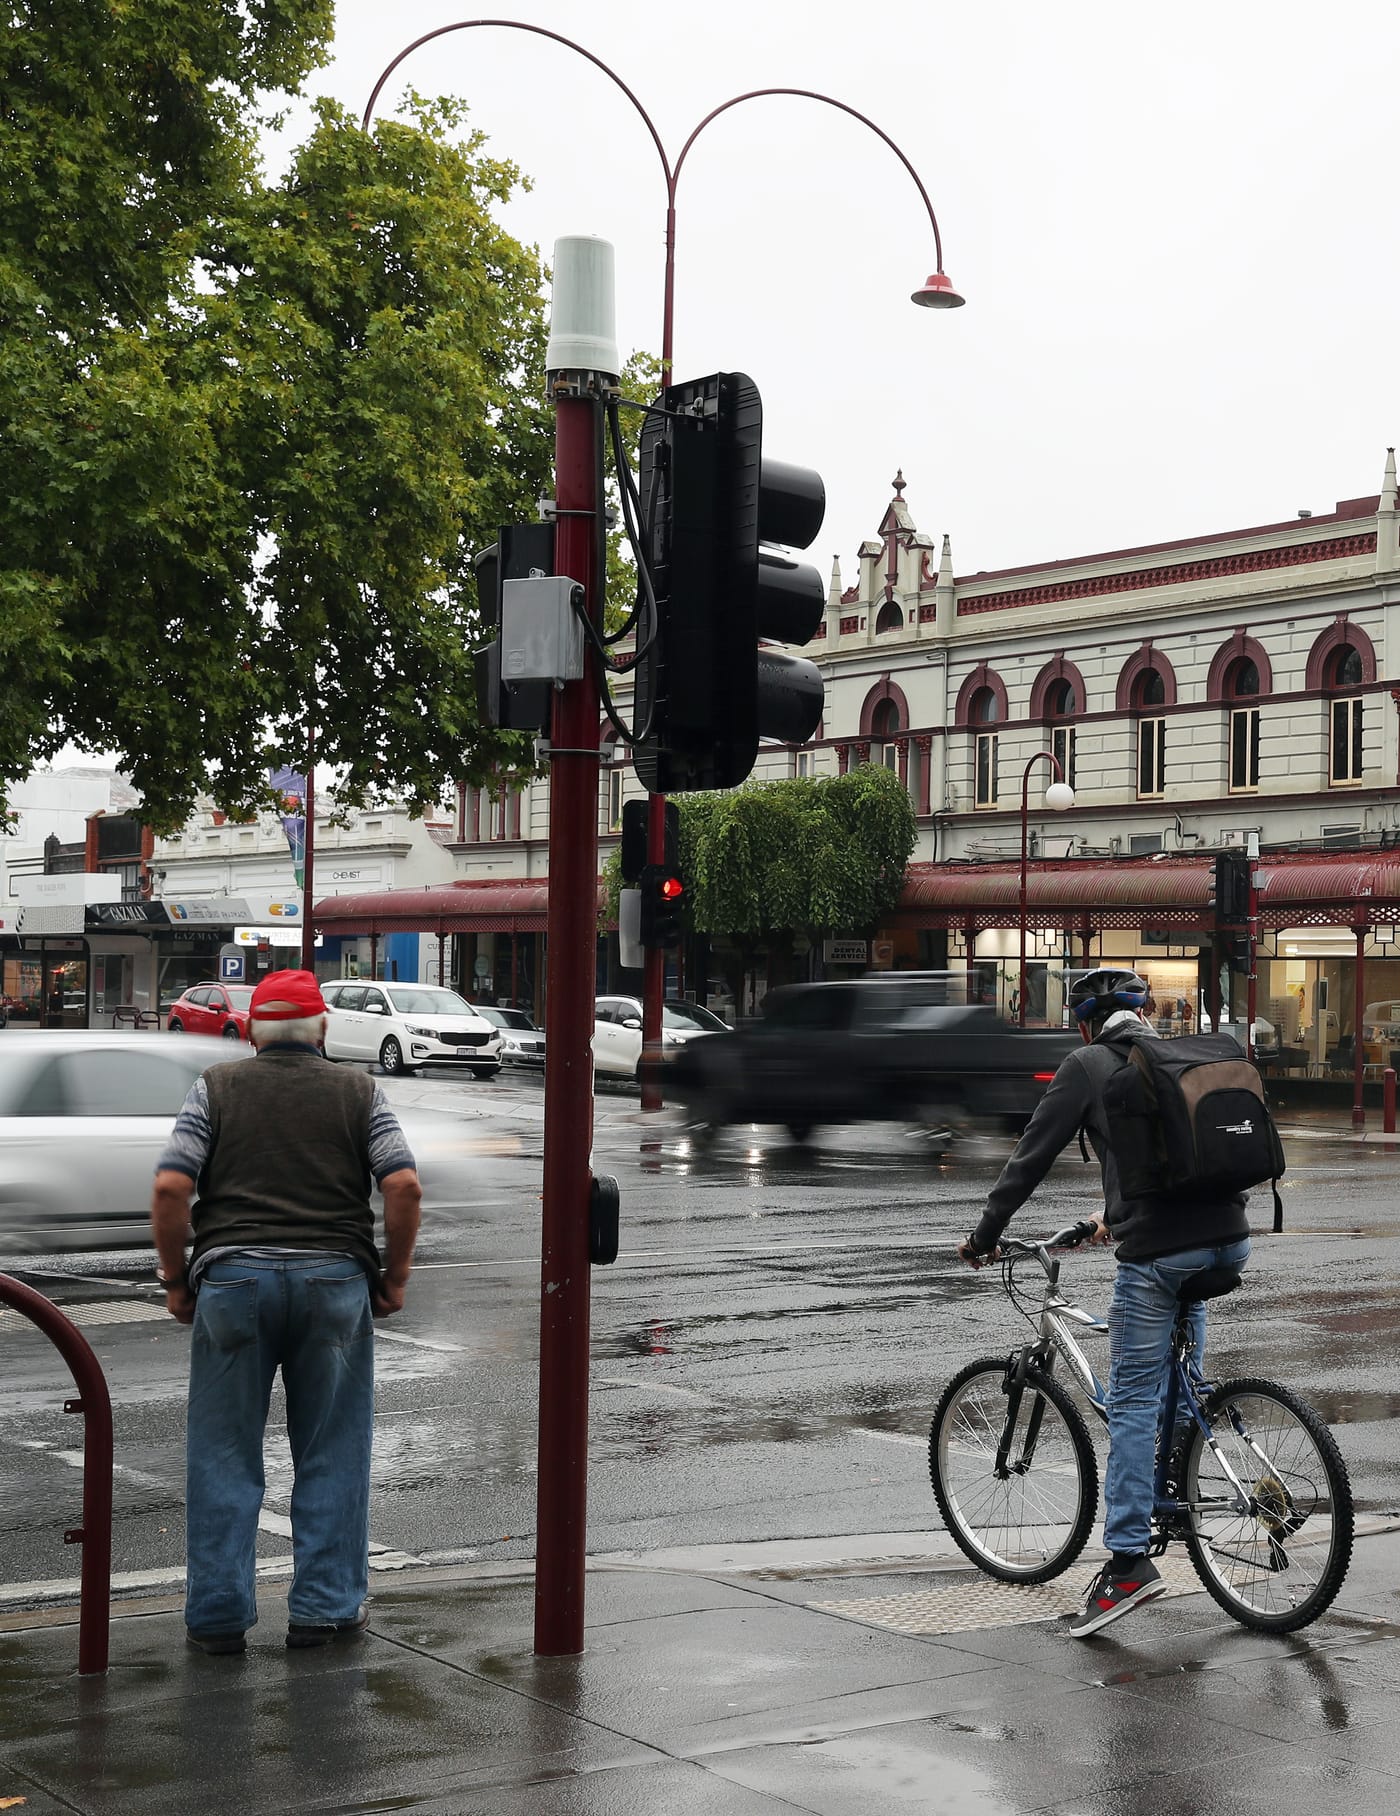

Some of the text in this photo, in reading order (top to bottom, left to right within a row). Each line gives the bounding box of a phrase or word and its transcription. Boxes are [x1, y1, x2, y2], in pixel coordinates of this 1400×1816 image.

[333, 870, 360, 880] CHEMIST
[109, 905, 149, 921] GAZMAN
[174, 931, 219, 941] GAZMAN
[226, 959, 240, 976] P
